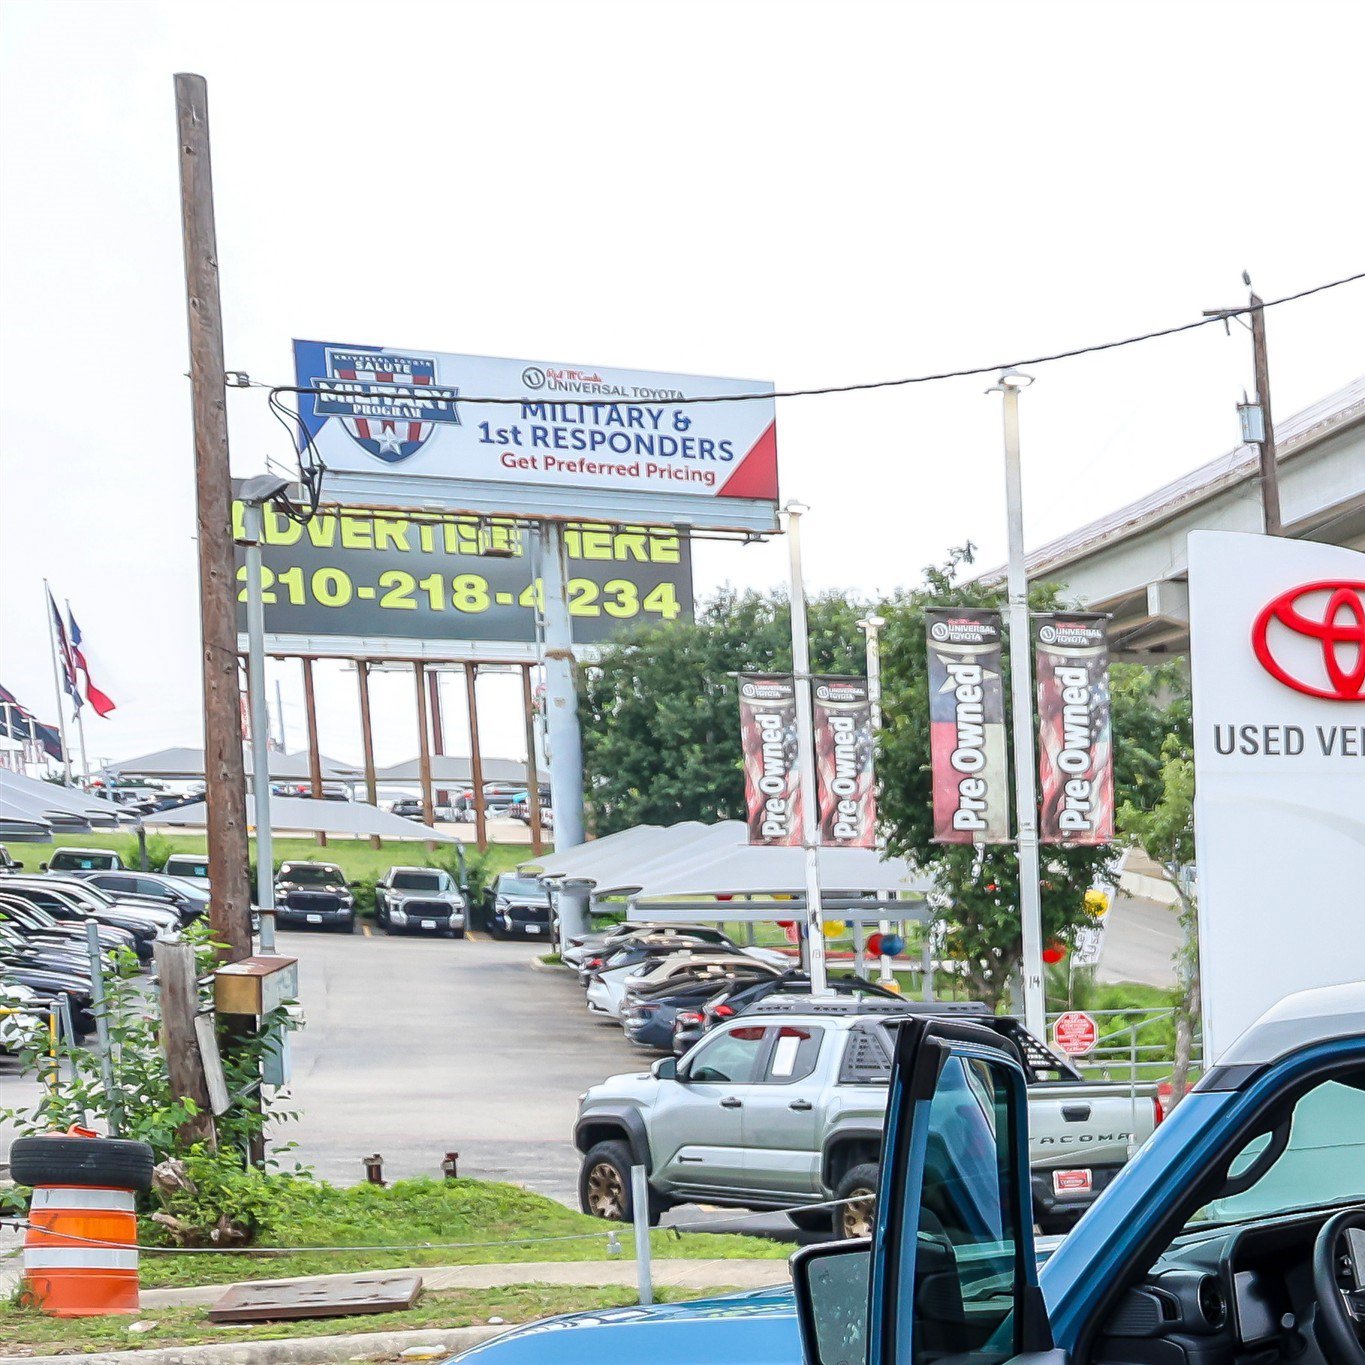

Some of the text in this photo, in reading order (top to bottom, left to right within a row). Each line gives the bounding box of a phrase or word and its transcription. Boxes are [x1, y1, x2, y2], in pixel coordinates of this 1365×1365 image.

[355, 361, 412, 374] SALUTE
[318, 382, 451, 411] MILITARY
[547, 379, 686, 401] UNIVERSAL TOYOTA
[352, 404, 422, 419] PROGRAM
[521, 397, 692, 432] MILITARY &
[478, 420, 735, 462] 1st RESPONDERS
[500, 452, 716, 487] Get Preferred Pricing
[235, 565, 682, 620] 210-218-4234
[949, 663, 985, 773] Owned
[1057, 665, 1091, 774] Owned
[757, 713, 785, 795] Owned
[831, 716, 857, 796] Owned
[1213, 723, 1304, 756] USED
[762, 797, 787, 838] Pre
[833, 800, 858, 838] Pre
[954, 776, 988, 830] Pre
[1059, 779, 1091, 830] Pre
[1029, 975, 1041, 989] 14
